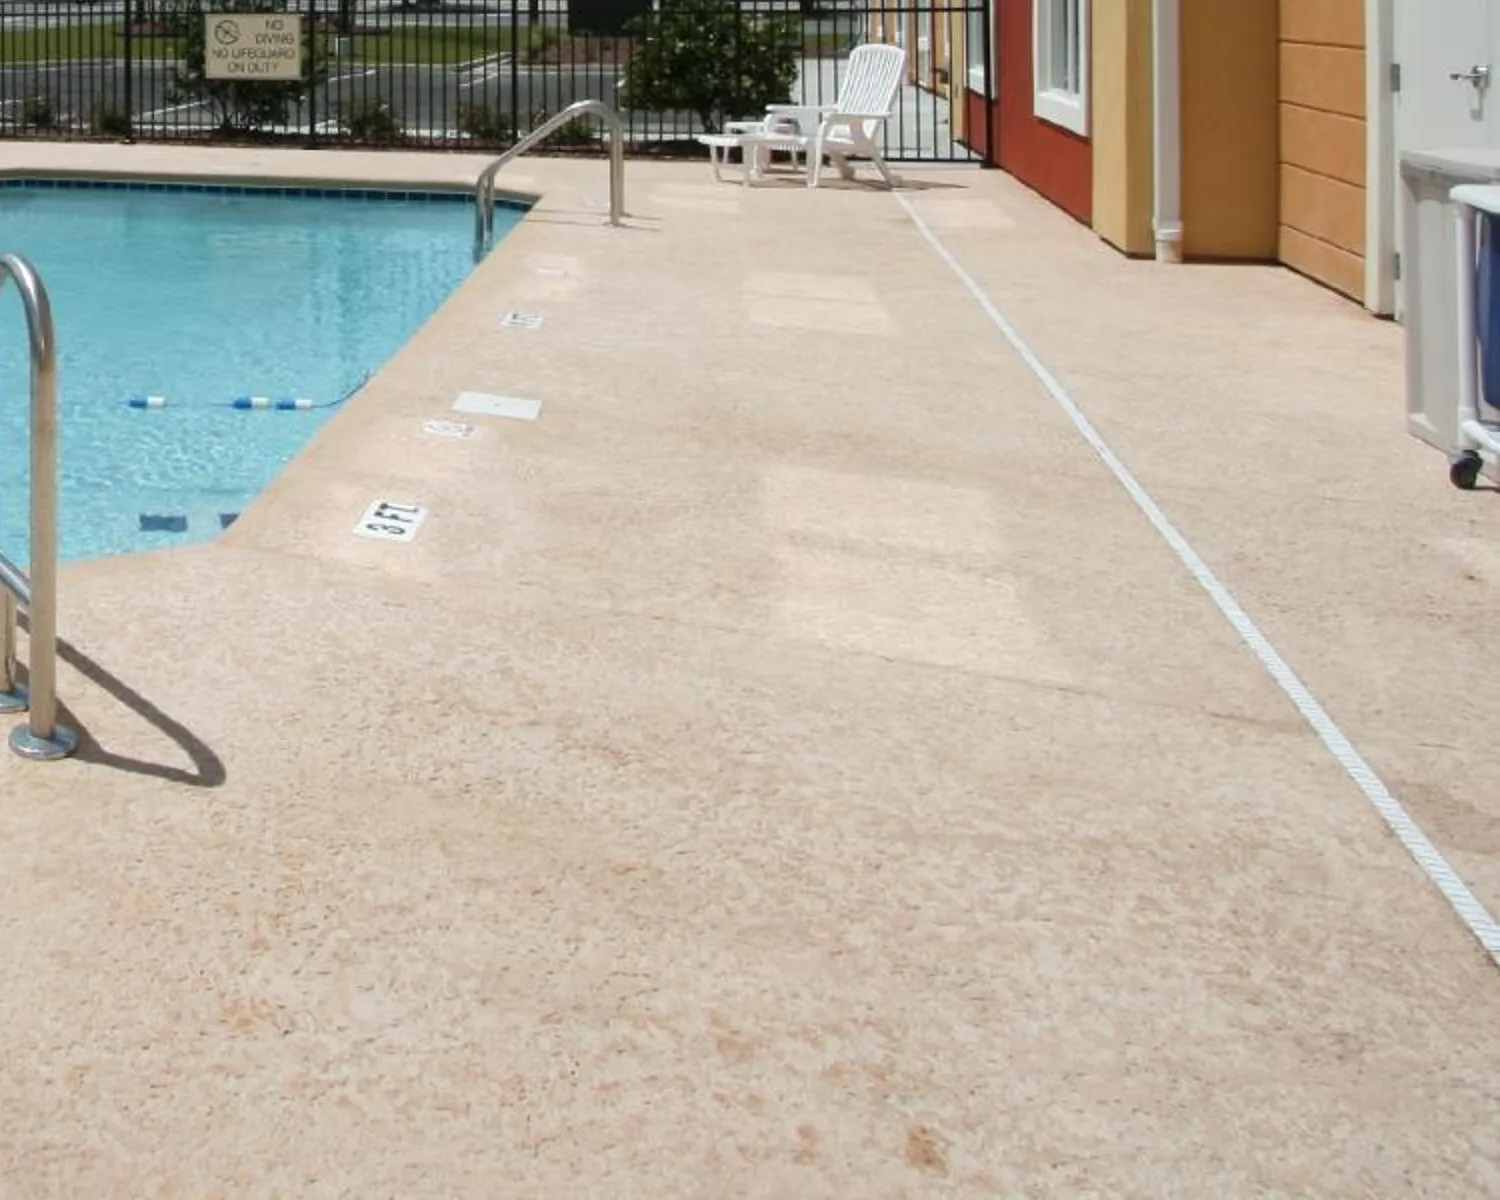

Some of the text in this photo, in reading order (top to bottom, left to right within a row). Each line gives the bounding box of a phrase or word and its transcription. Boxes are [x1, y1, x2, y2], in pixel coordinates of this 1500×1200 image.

[265, 19, 284, 31] NO
[255, 32, 295, 45] DIVING
[211, 47, 296, 59] NO LIFEGUARD
[227, 61, 279, 73] ON DUTY
[365, 502, 420, 536] 3 FT
